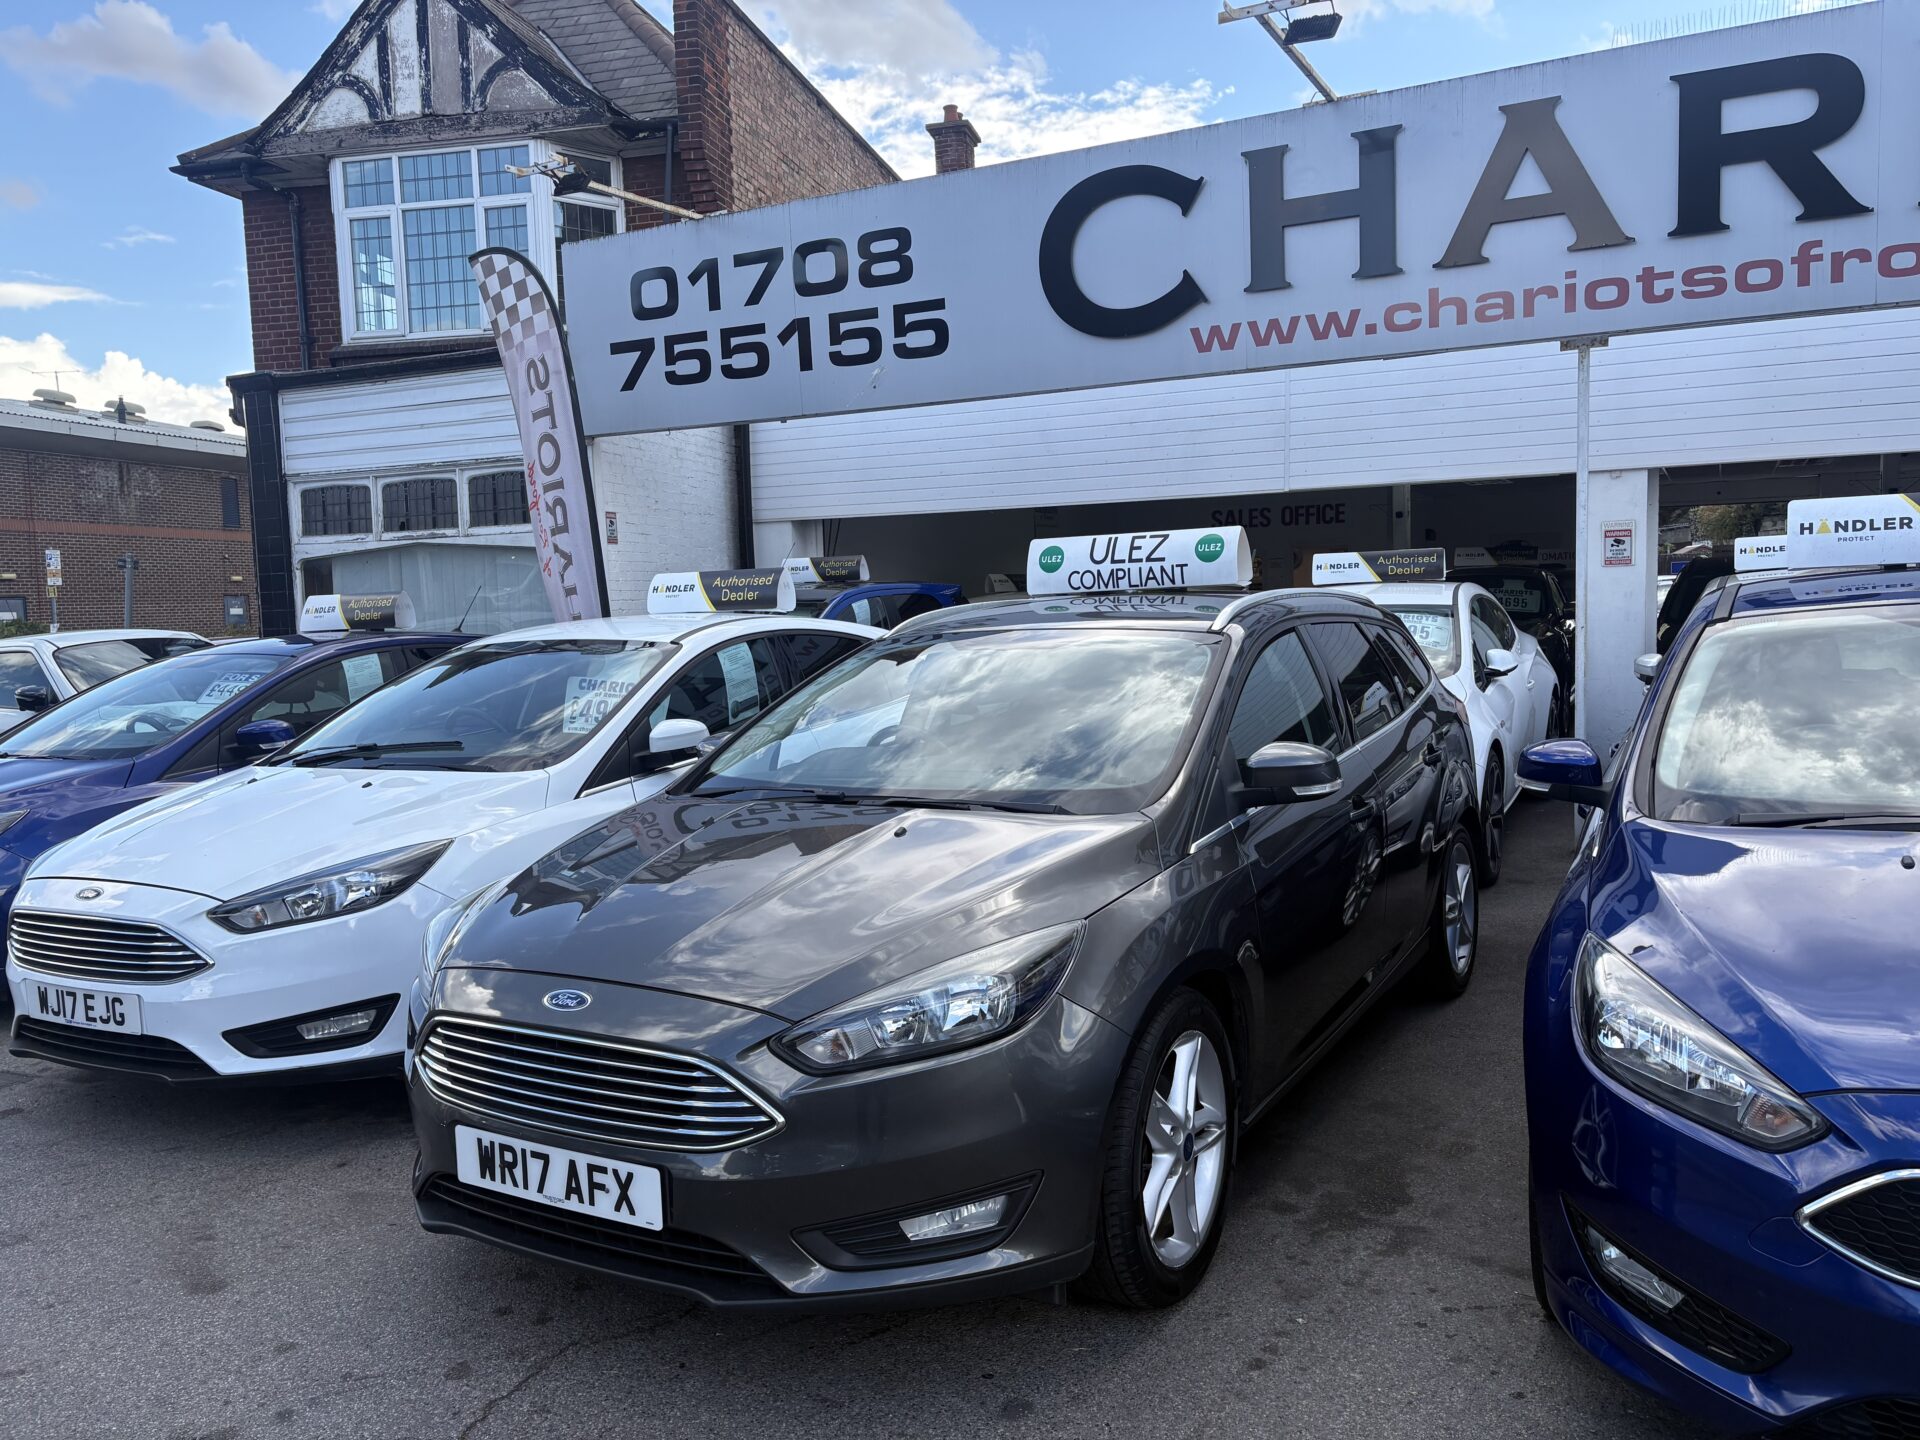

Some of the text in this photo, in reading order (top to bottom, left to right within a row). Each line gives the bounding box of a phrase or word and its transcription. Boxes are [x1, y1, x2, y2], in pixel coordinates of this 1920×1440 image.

[1039, 52, 1920, 338] CHAR
[630, 226, 914, 322] 01708
[1189, 239, 1920, 354] www.chariotsofro
[610, 297, 950, 392] 755155
[1211, 503, 1346, 528] SALES OFFICE
[1837, 535, 1875, 543] PROTECT
[1089, 533, 1171, 565] ULEZ
[1198, 543, 1222, 552] ULEZ
[819, 559, 857, 568] Authorised
[1041, 555, 1062, 564] ULEZ
[1377, 553, 1437, 565] Authorised
[825, 568, 849, 576] Dealer
[1068, 563, 1189, 591] COMPLIANT
[1388, 565, 1425, 575] Dealer
[712, 573, 774, 588] Authorised
[721, 588, 759, 601] Dealer
[348, 596, 394, 609] Authorised
[354, 609, 382, 620] Dealer
[1399, 614, 1439, 623] RIOTS
[37, 985, 126, 1027] WJ17 EJG
[552, 992, 581, 1007] Ford
[477, 1137, 636, 1217] WR17 AFX
